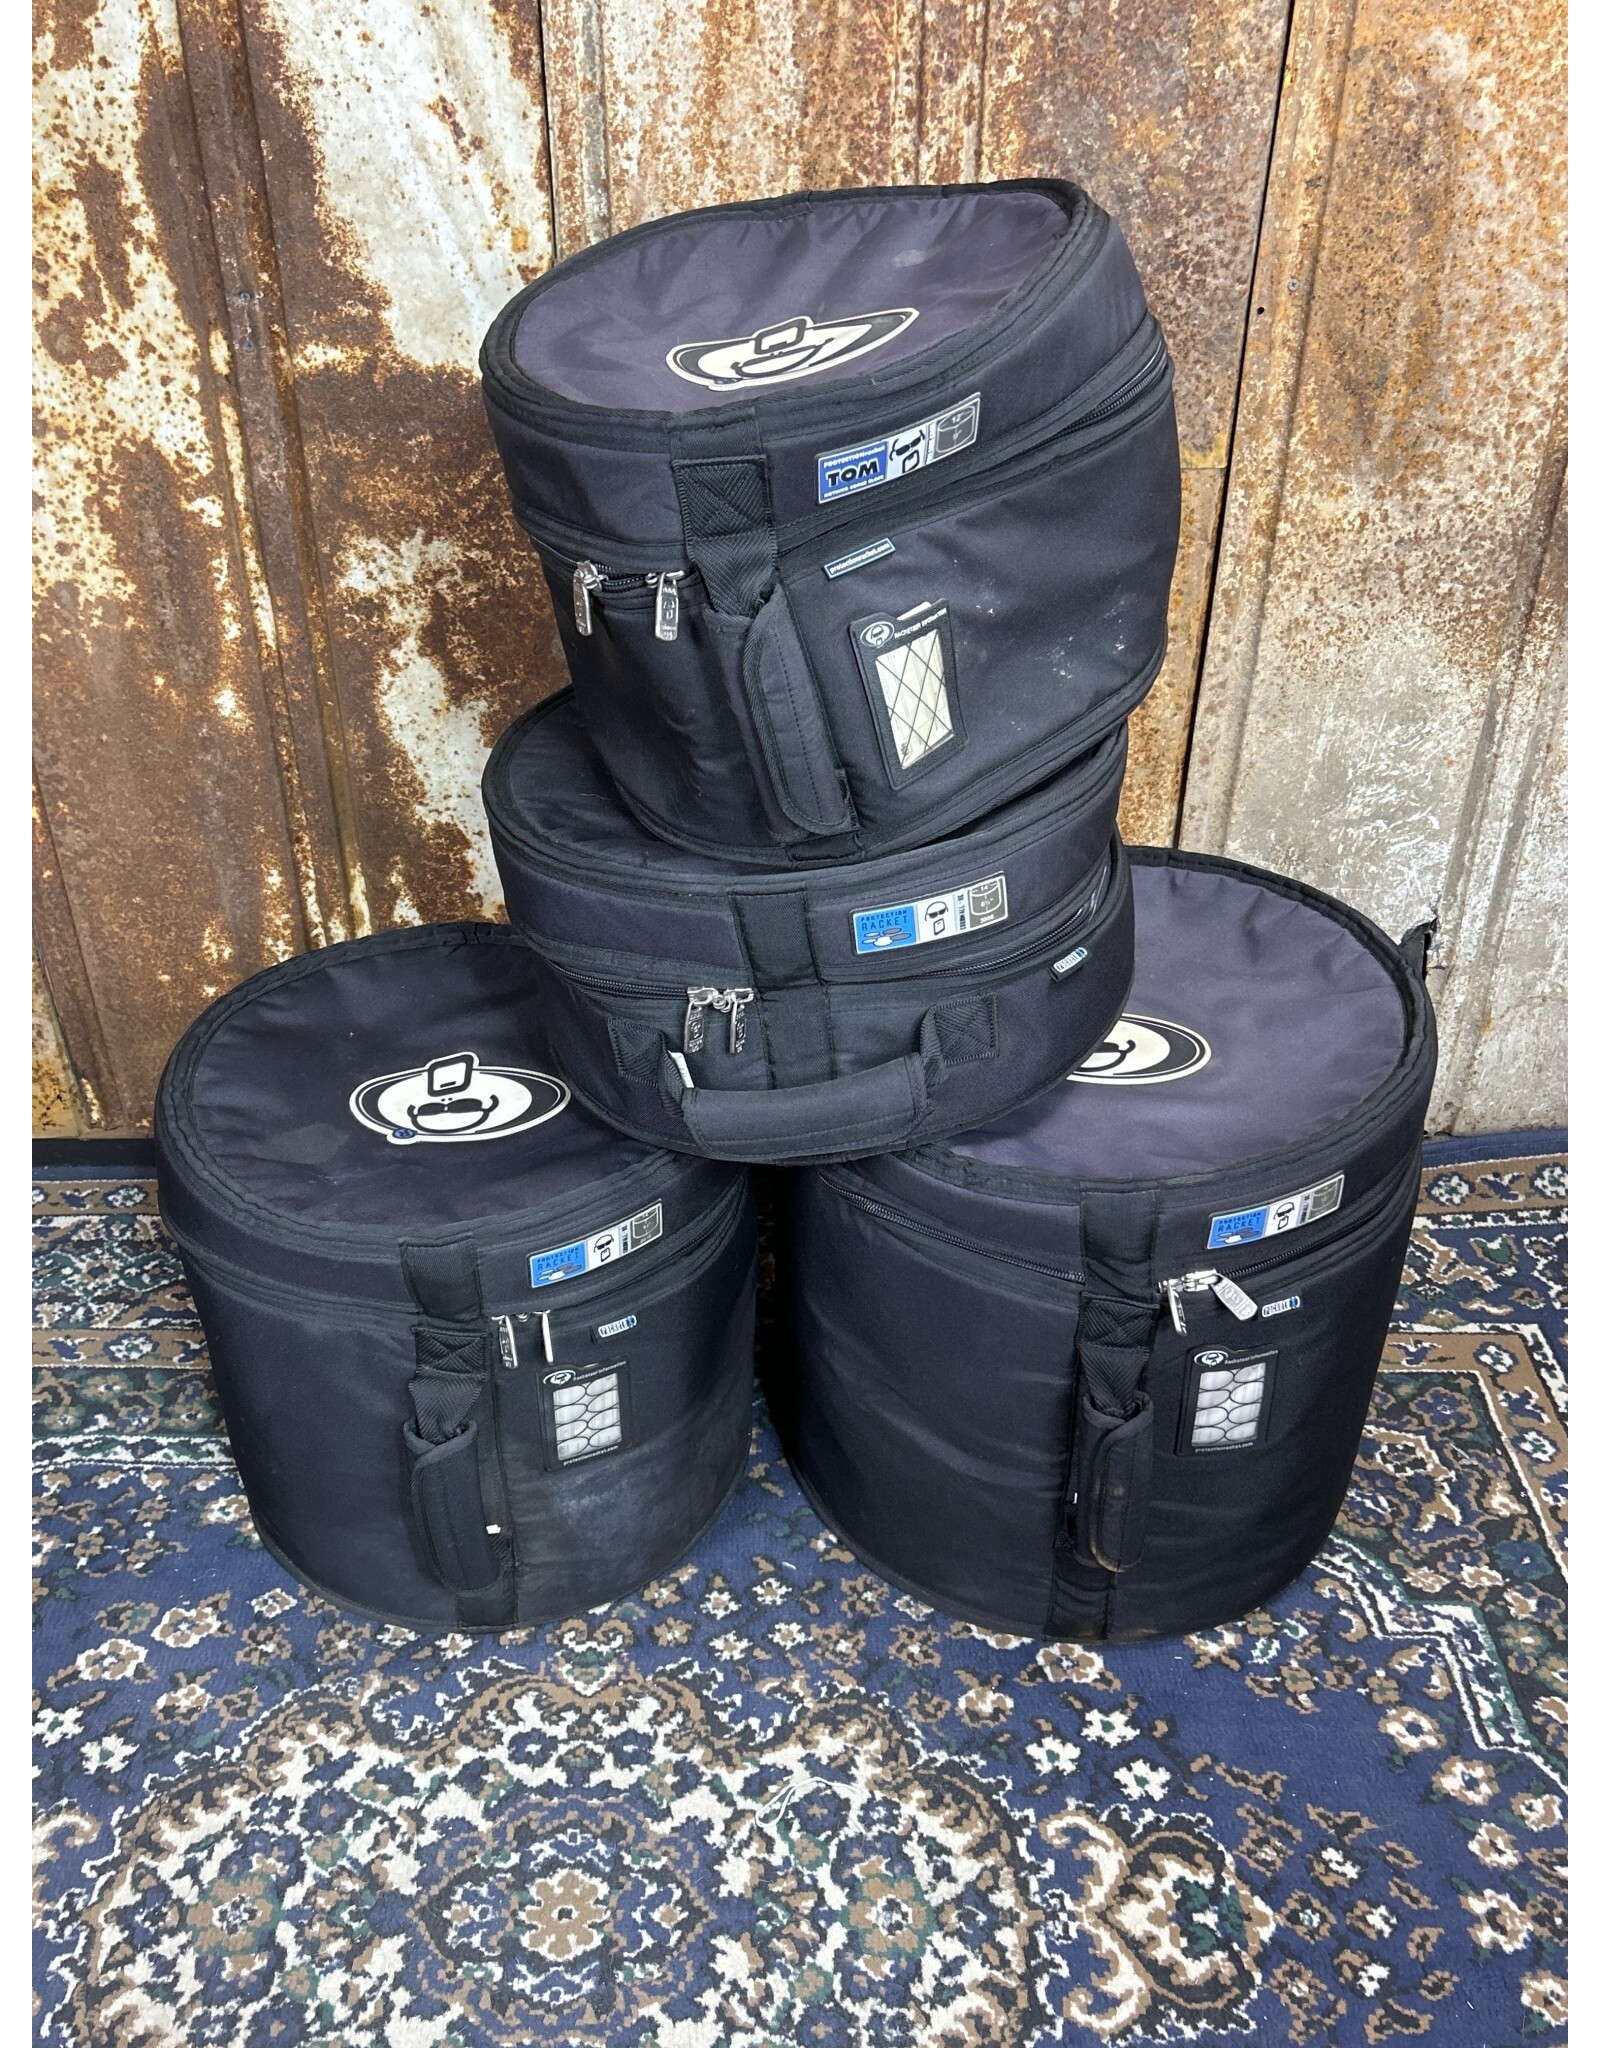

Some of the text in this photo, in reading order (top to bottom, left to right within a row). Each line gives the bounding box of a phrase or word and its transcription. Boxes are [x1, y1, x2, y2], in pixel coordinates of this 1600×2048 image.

[826, 458, 880, 488] TOM
[861, 910, 907, 922] PROTECTION
[862, 915, 908, 931] RACKET
[1218, 1217, 1260, 1232] RACKET
[1219, 1212, 1261, 1224] PROTECTION
[538, 1248, 579, 1263] PROTECTION
[538, 1252, 579, 1270] RACKET
